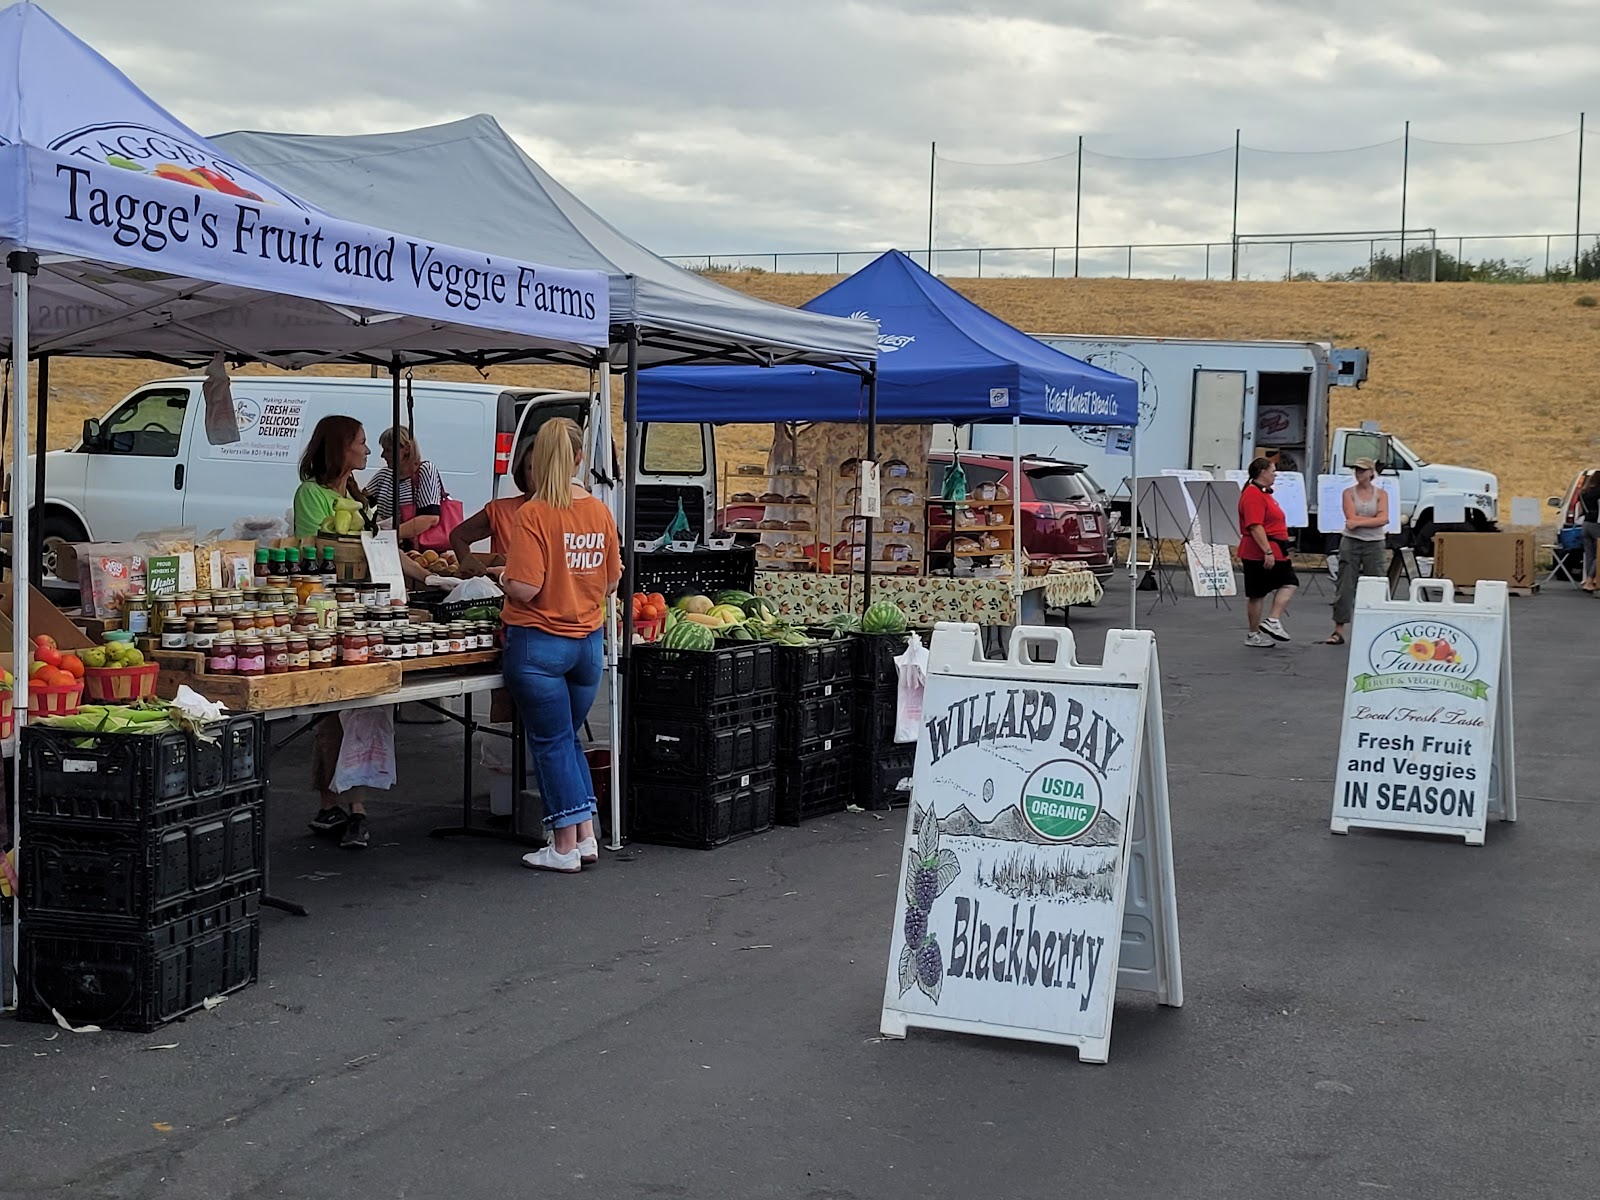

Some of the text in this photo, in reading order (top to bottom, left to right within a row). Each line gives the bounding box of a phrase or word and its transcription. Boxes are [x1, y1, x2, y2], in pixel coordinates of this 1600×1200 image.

[70, 135, 236, 182] TAGGE'S
[56, 164, 596, 321] Tagge's Fruit and Veggie Farms
[263, 397, 282, 405] Making
[264, 404, 301, 415] FRESH AND
[1048, 386, 1068, 413] Great
[1067, 384, 1091, 415] Harvest
[1091, 390, 1109, 416] Bread
[258, 426, 297, 438] DELIVERY!
[260, 416, 300, 427] DELICIOUS
[220, 448, 250, 456] Taylorsville
[563, 532, 605, 550] FLOUR
[565, 551, 604, 570] CHILD
[150, 577, 176, 592] Utah's
[1390, 625, 1460, 645] TAGGE'S
[1376, 649, 1469, 674] Famous
[1366, 675, 1475, 693] FRUIT & VEGGIE FARMS
[1351, 705, 1485, 727] Local Fresh Taste
[925, 688, 1125, 780] WILLARD BAY
[1357, 732, 1472, 756] Fresh Fruit
[1348, 757, 1476, 782] and Veggies
[1041, 777, 1085, 800] USDA
[1343, 781, 1475, 818] IN SEASON
[1031, 800, 1088, 822] ORGANIC
[947, 896, 1105, 1012] Blackberry
